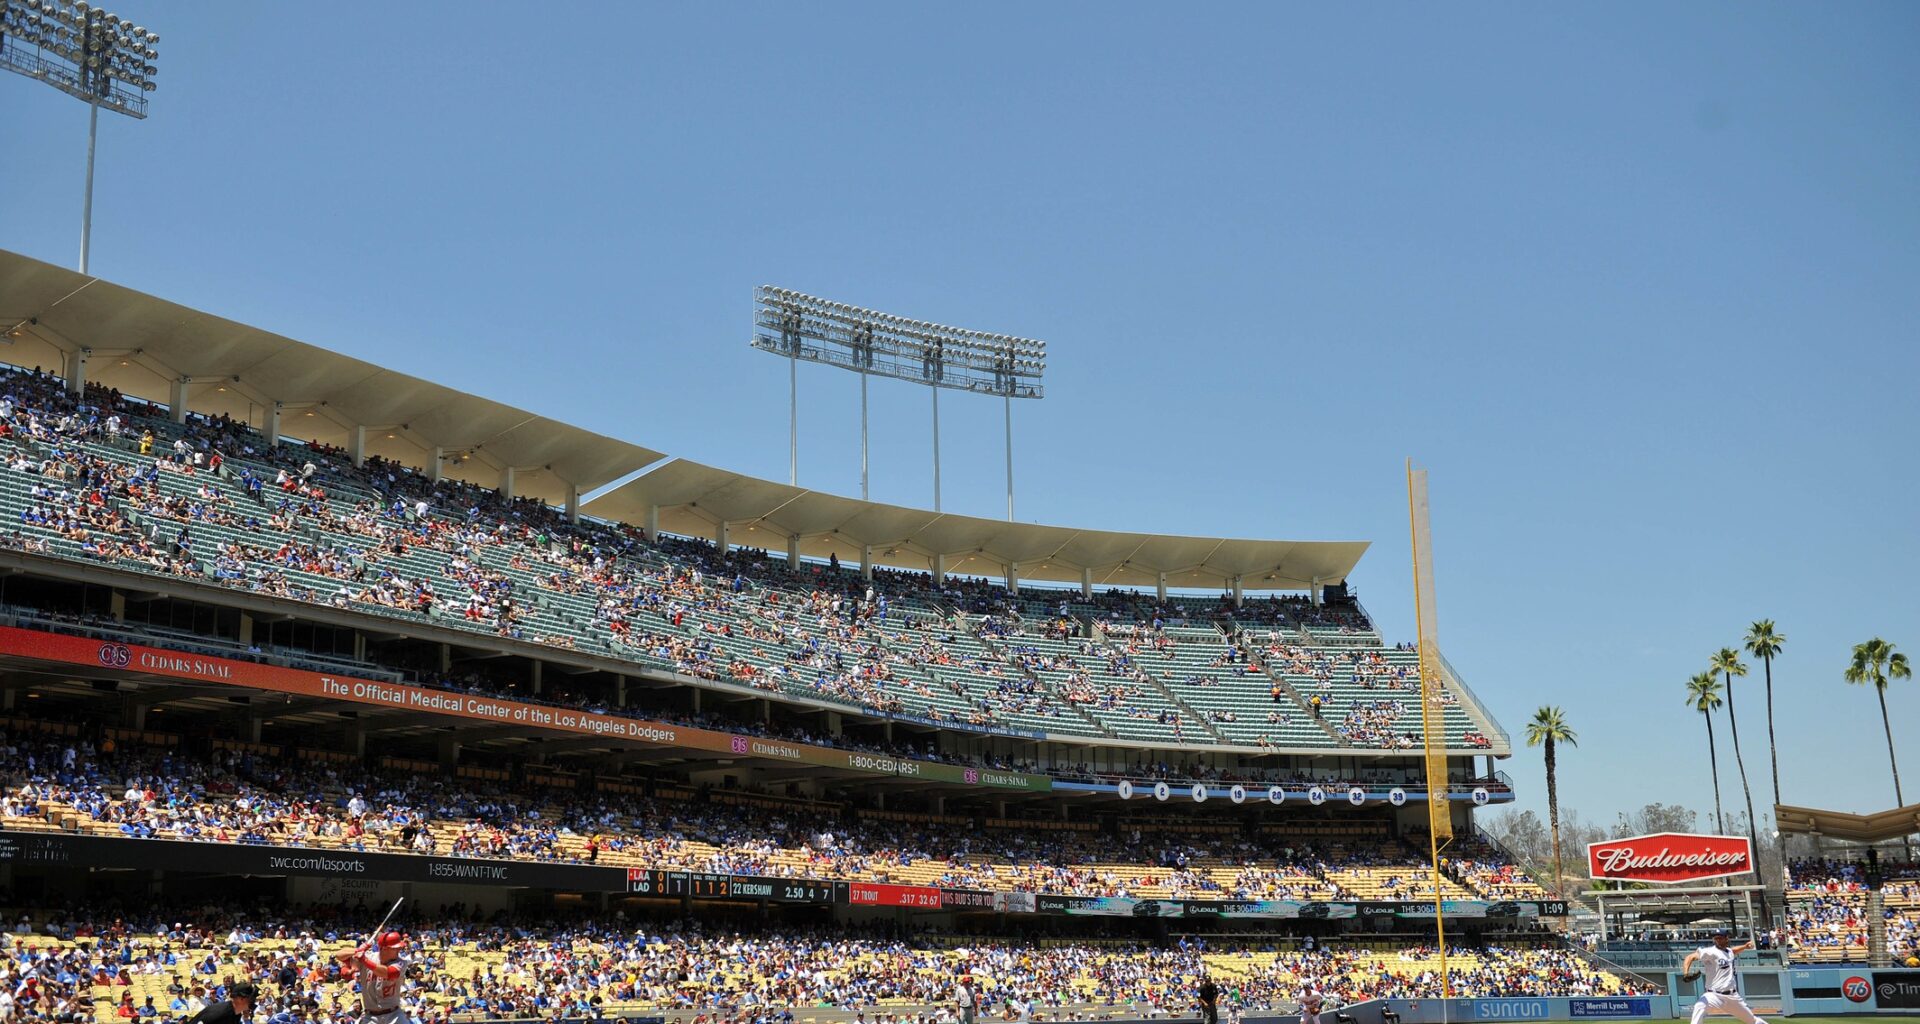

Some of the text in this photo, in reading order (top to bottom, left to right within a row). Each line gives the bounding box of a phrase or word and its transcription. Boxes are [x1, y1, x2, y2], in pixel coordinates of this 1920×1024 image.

[141, 652, 191, 672] CEDARS
[321, 678, 675, 741] The Official Medical Center of the Los Angeles Dodgers
[849, 755, 920, 775] 1-800-CEDARS-1
[1160, 787, 1165, 797] 2
[1234, 790, 1242, 799] 19
[1272, 791, 1282, 800] 20
[1311, 791, 1322, 800] 24
[1352, 791, 1362, 800] 32
[1392, 791, 1403, 800] 39
[1475, 791, 1486, 800] 53
[270, 857, 365, 873] twc.com/lasports
[1596, 847, 1745, 872] Budweiser
[429, 863, 508, 879] 1-855-WANT-TWC
[633, 870, 664, 881] LAA 0
[342, 879, 379, 889] SECURITY
[633, 882, 664, 893] LAD 0
[676, 880, 681, 892] 1
[695, 881, 727, 894] 1 1 2
[733, 883, 773, 896] 22 KERSHAW
[785, 887, 829, 900] 2.50 4 7
[853, 890, 878, 901] 27 TROUT
[941, 892, 954, 904] THIS
[955, 893, 971, 905] BUD'S
[972, 894, 982, 906] FOR
[900, 894, 938, 905] .317 32 67
[1068, 900, 1080, 910] THE
[1223, 905, 1236, 913] THE
[1401, 905, 1416, 913] THE
[1543, 903, 1563, 914] 1:09
[1847, 981, 1868, 997] 76
[1481, 1002, 1542, 1017] sunrun
[1609, 1001, 1628, 1010] Lynch
